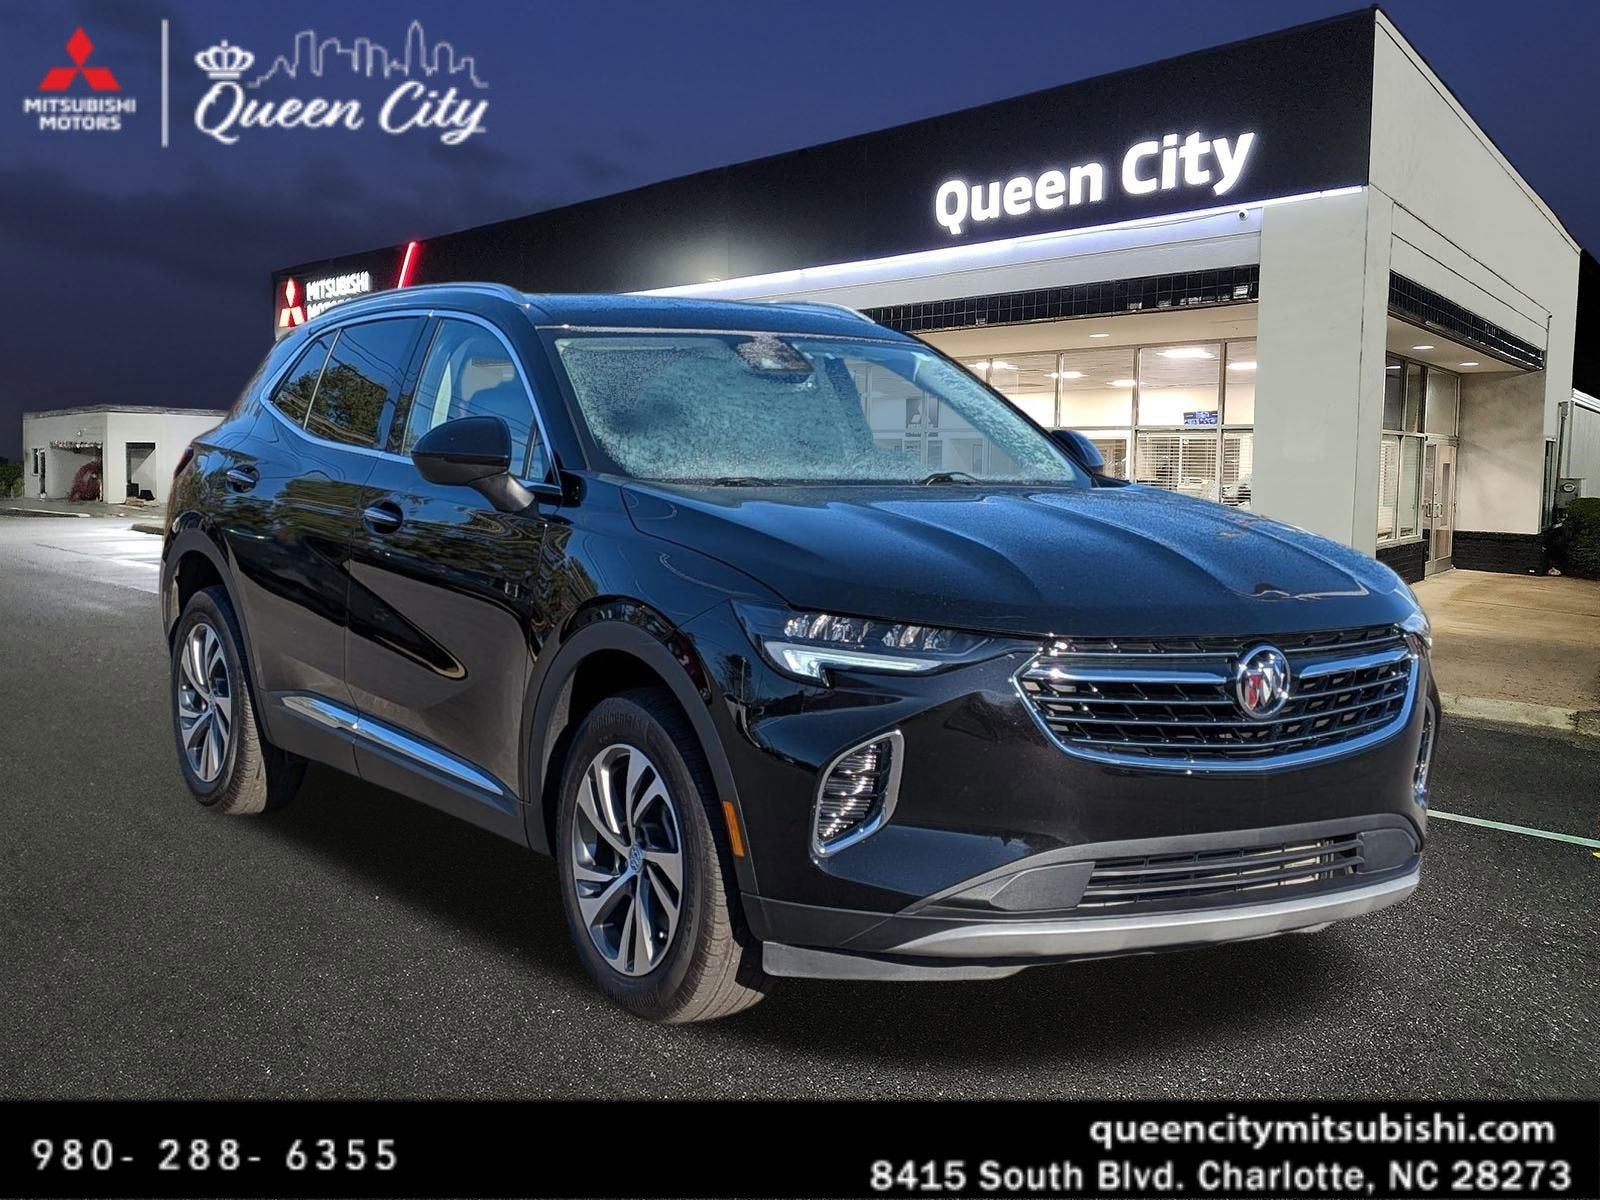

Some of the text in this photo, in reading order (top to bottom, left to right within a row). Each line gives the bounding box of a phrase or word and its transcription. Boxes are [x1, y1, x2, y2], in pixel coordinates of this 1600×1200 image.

[935, 131, 1256, 235] Queen City
[306, 271, 369, 301] MITSUBISHI
